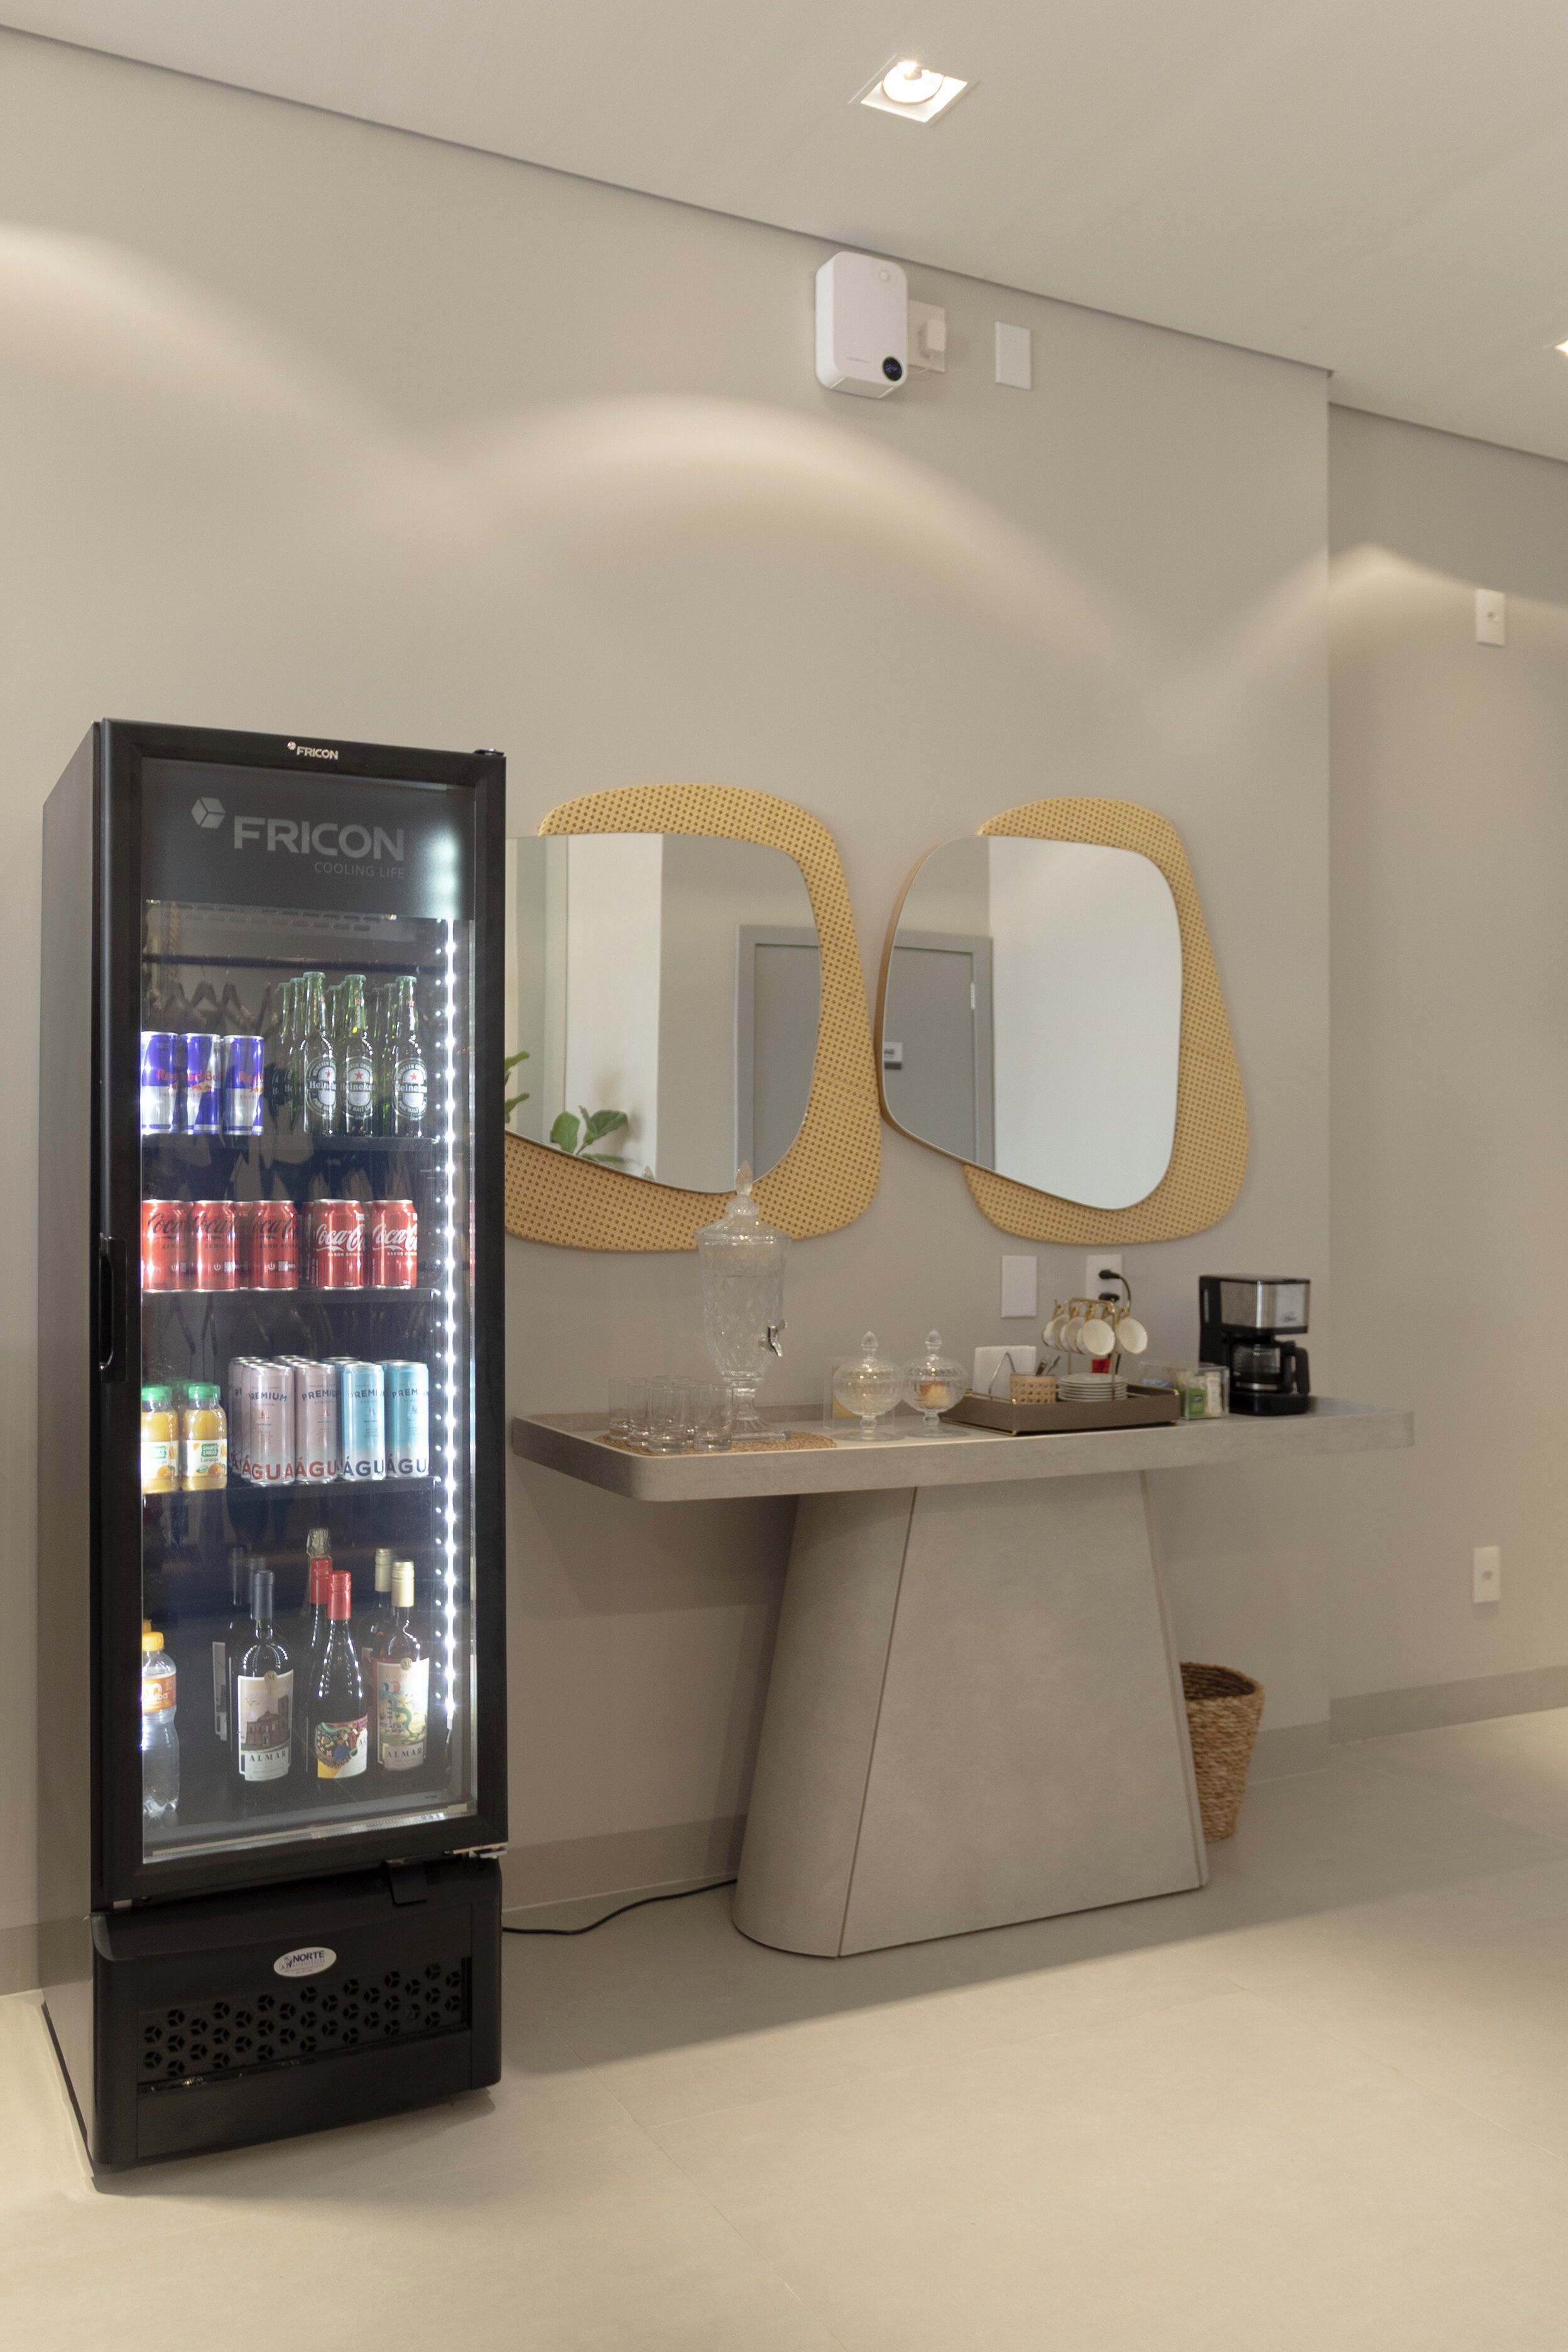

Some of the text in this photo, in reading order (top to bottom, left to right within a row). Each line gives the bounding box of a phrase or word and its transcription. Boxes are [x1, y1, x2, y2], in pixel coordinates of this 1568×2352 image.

[297, 746, 339, 760] FRICON
[234, 815, 405, 861] FRICON
[314, 861, 405, 879] COOLING LIFE
[296, 1456, 337, 1478] ÁGU
[344, 1456, 385, 1477] ÁGU
[386, 1454, 427, 1474] ÁGU
[293, 1950, 325, 1963] NORTE
